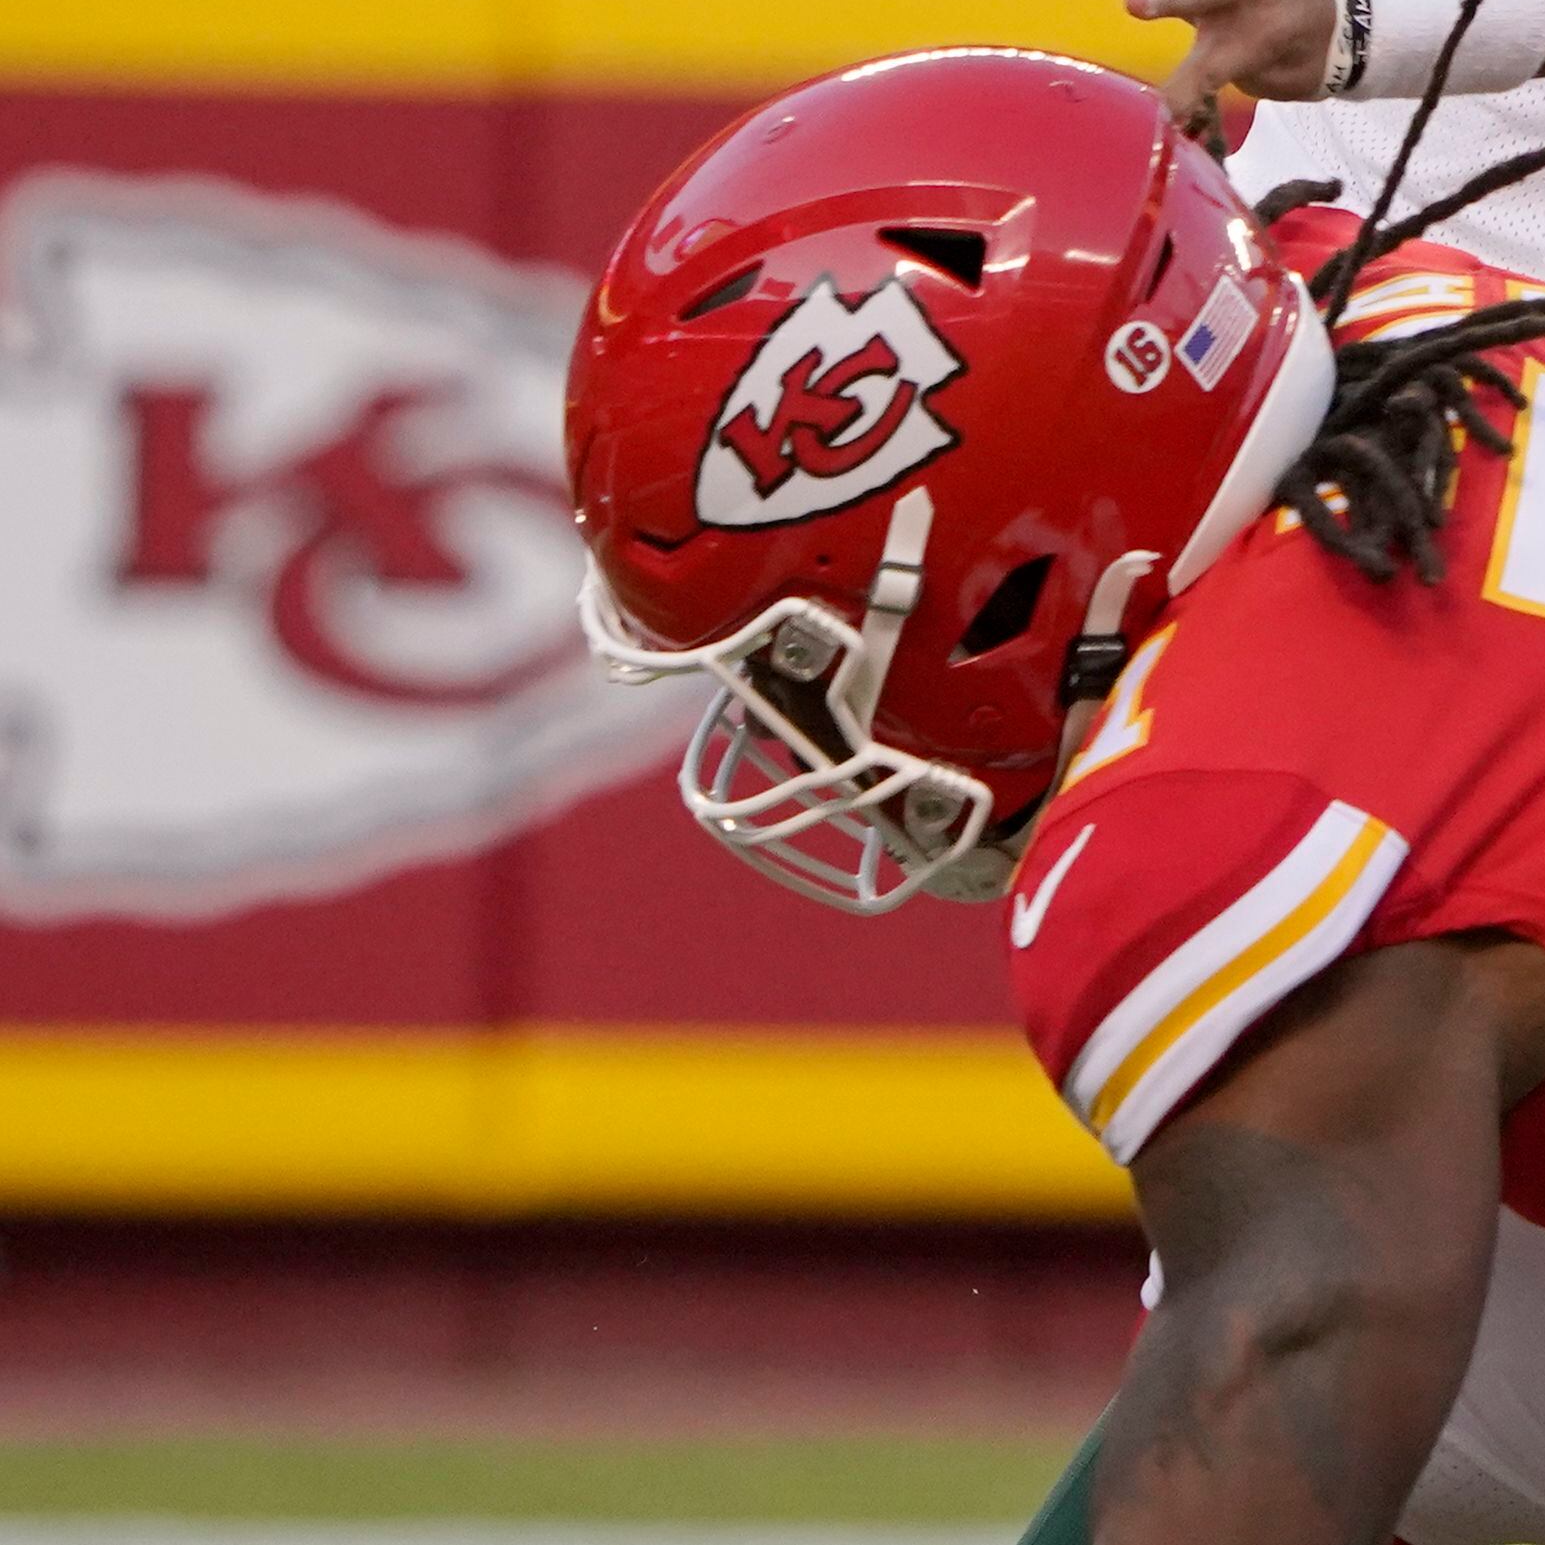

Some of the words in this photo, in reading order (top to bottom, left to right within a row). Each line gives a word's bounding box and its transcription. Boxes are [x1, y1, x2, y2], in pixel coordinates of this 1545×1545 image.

[719, 330, 919, 502] KC
[1114, 326, 1164, 388] 16
[117, 378, 590, 708] KC
